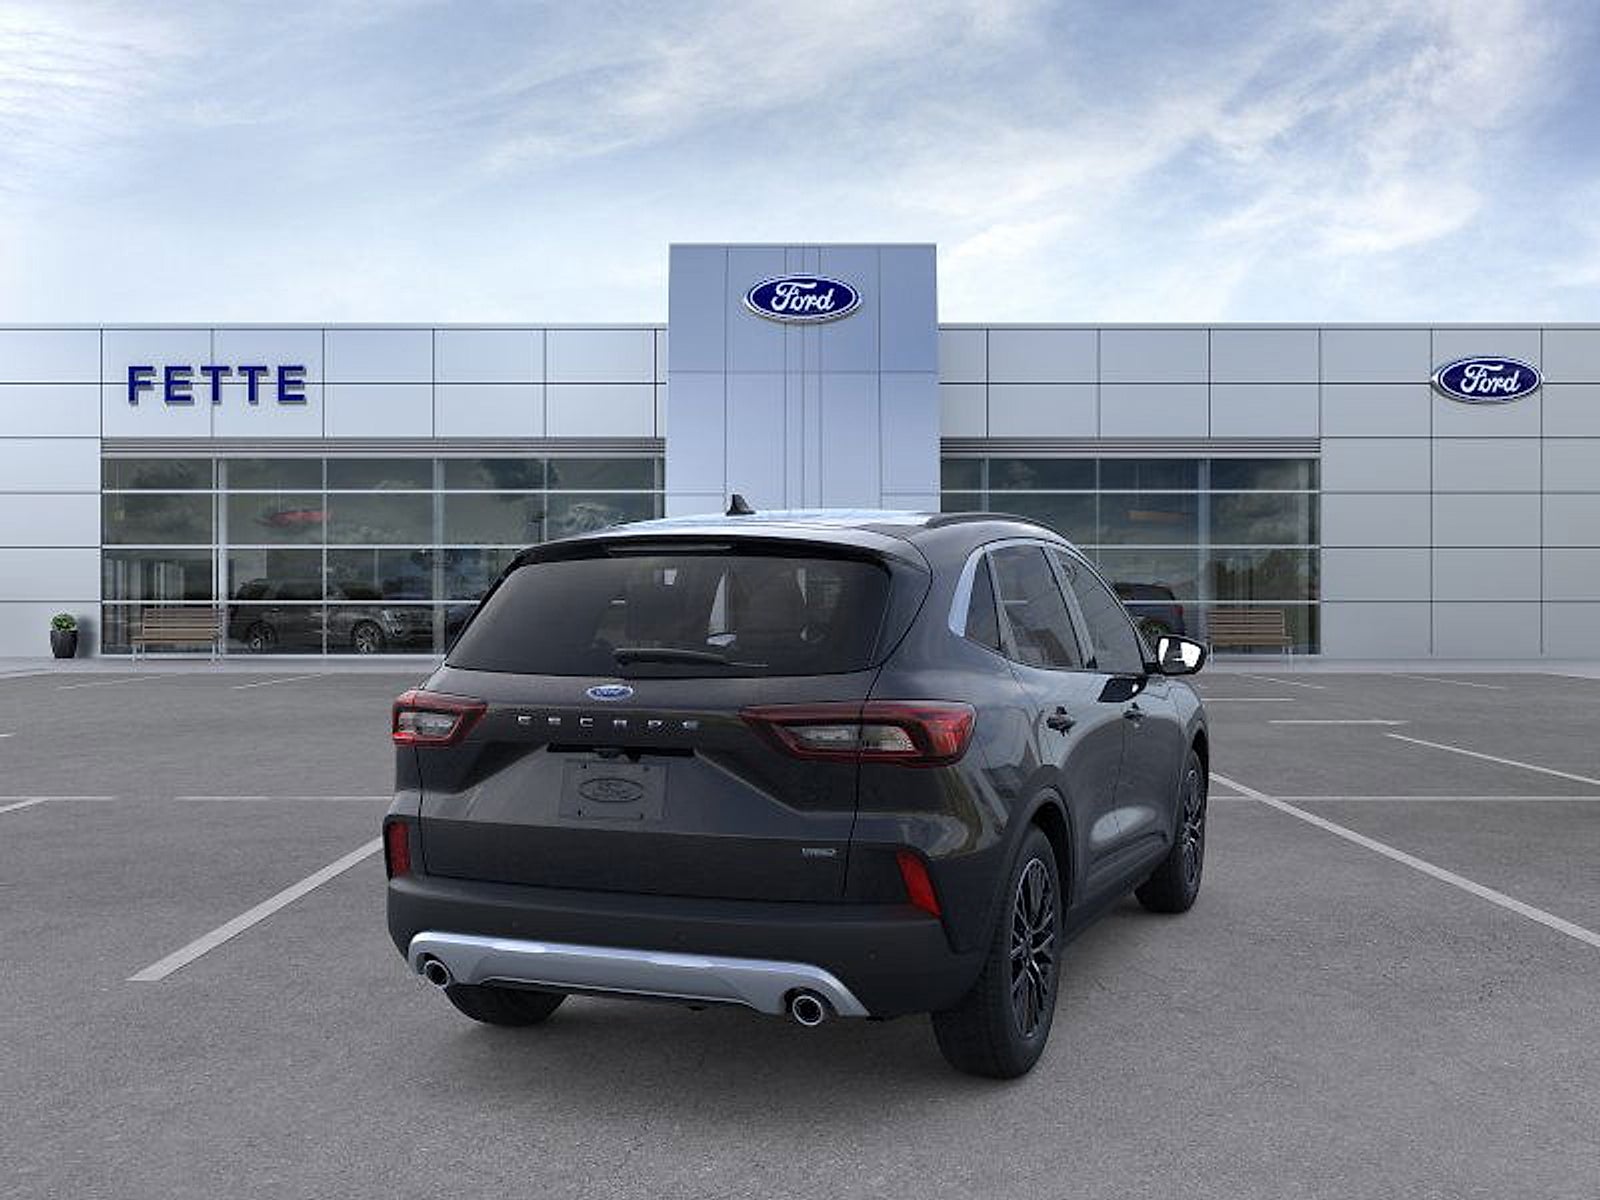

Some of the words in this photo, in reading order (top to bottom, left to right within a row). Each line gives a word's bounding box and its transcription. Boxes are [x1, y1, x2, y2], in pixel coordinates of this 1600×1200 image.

[771, 282, 835, 311] Ford
[128, 366, 306, 404] FETTE
[1460, 364, 1522, 393] Ford
